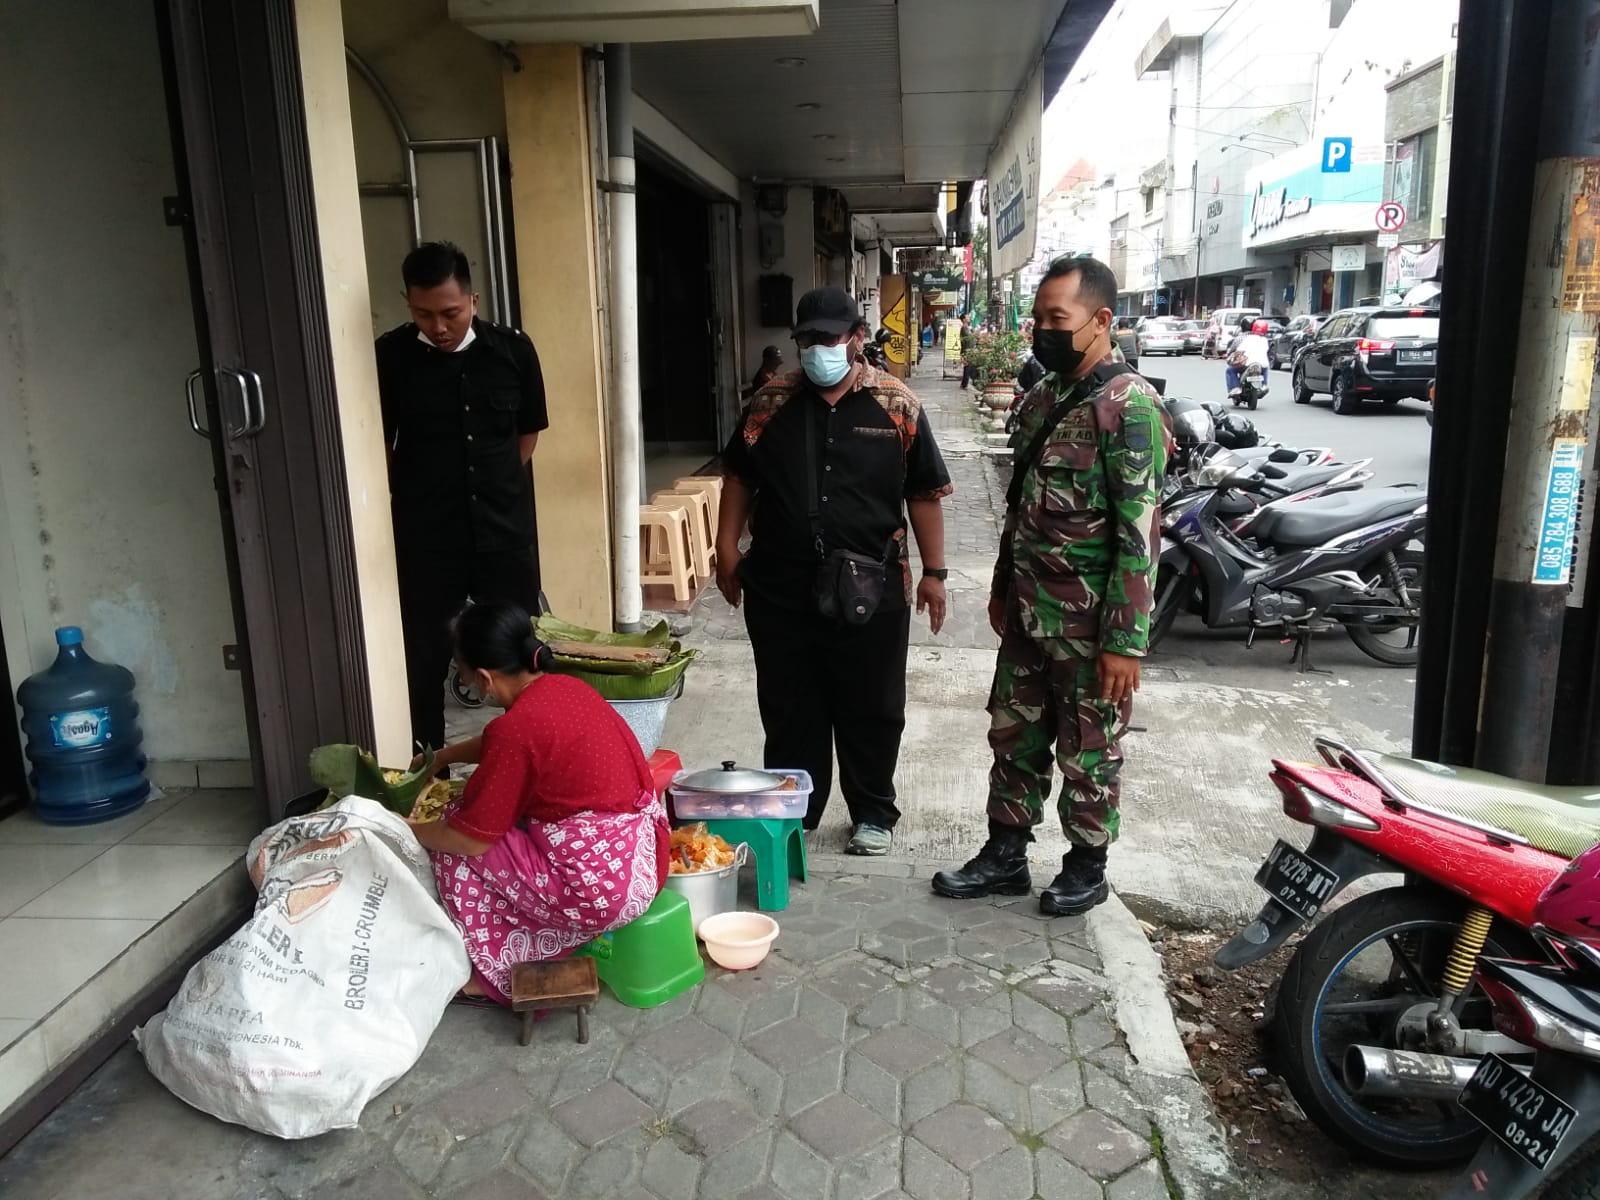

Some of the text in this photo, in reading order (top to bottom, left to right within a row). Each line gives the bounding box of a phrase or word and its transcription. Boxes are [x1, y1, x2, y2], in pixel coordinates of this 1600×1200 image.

[1328, 142, 1346, 168] P
[1384, 207, 1399, 227] P
[1552, 472, 1574, 494] 688
[1549, 497, 1570, 519] 308
[1545, 522, 1566, 543] 784
[1541, 546, 1563, 568] 085
[1474, 1058, 1503, 1088] AD
[1500, 1076, 1545, 1120] 4423
[1541, 1106, 1569, 1141] JA
